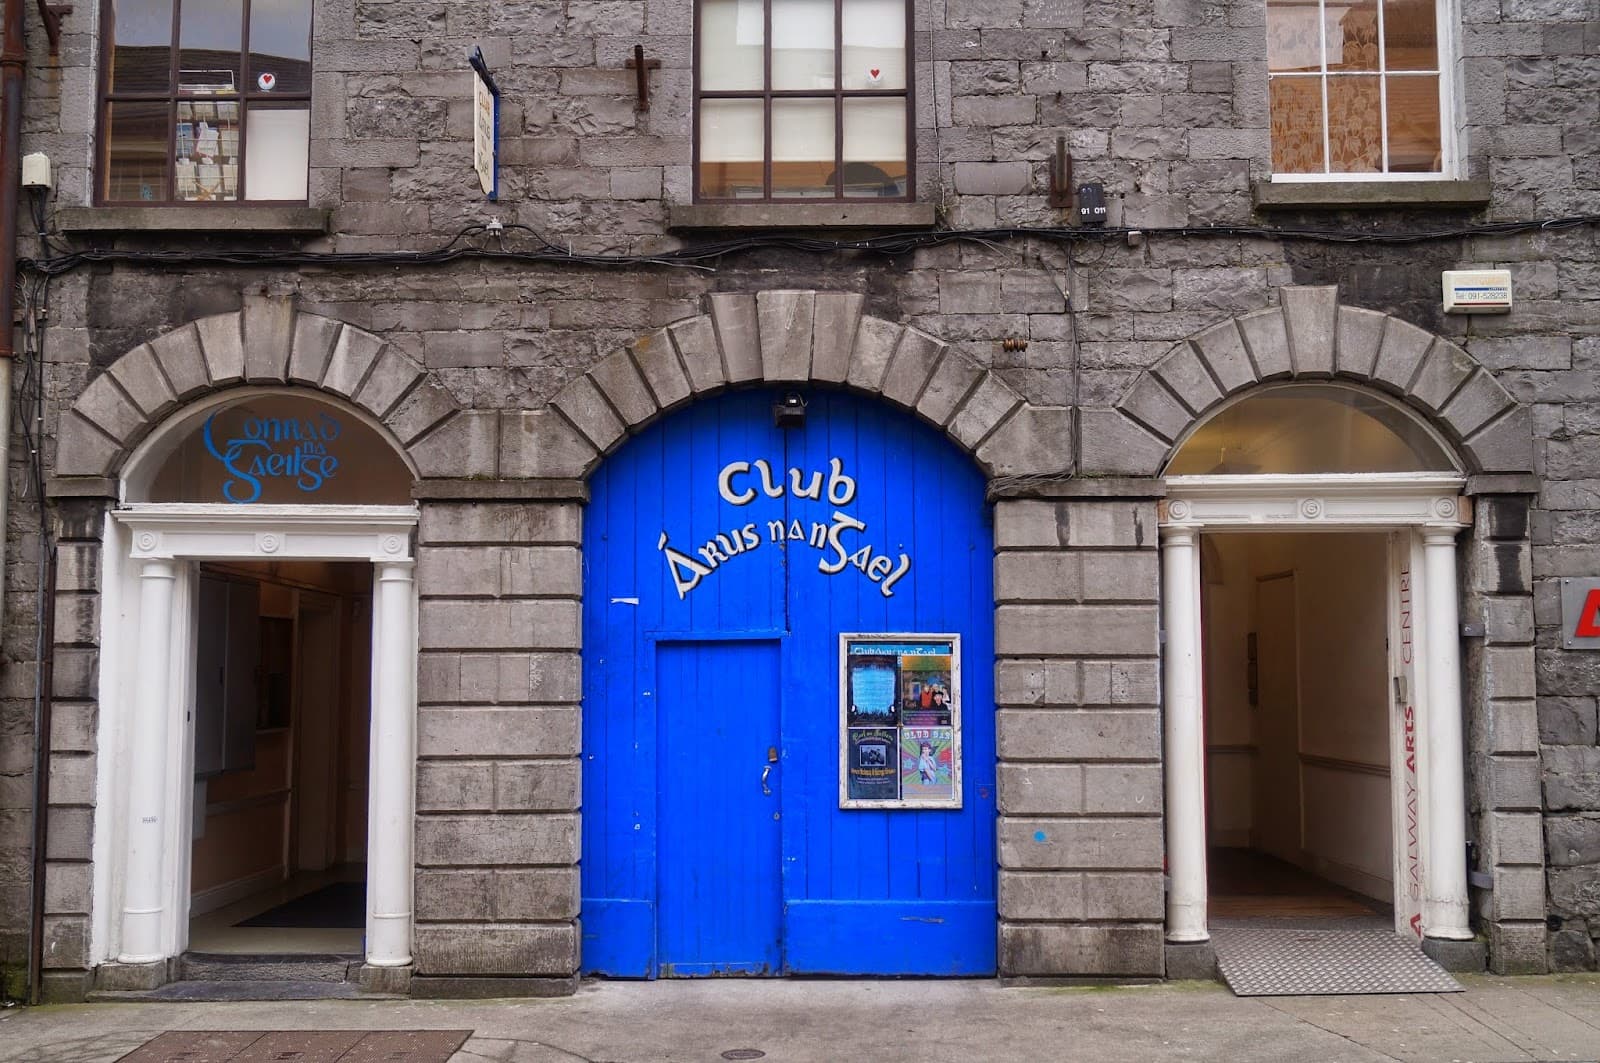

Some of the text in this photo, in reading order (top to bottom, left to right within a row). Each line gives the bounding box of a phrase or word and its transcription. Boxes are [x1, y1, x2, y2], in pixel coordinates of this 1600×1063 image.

[718, 457, 856, 505] Club
[1400, 562, 1411, 664] CENTRE
[1404, 706, 1416, 774] ARTS
[1406, 781, 1420, 901] GALWAY
